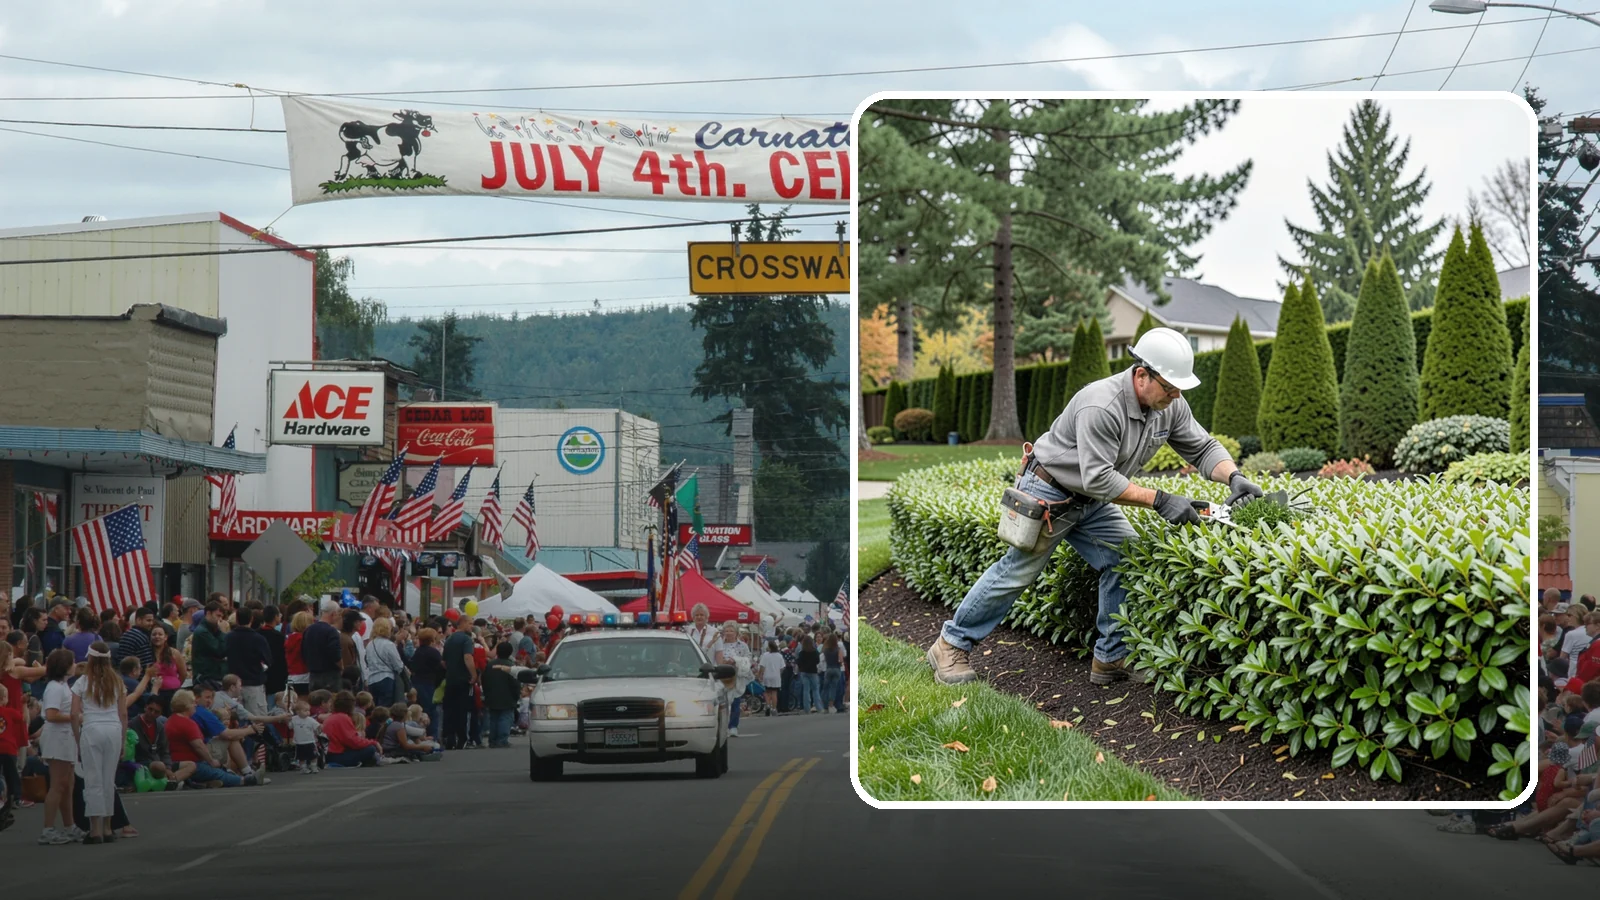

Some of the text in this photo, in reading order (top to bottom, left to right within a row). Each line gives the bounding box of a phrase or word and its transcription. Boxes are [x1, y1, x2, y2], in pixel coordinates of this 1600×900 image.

[481, 141, 605, 192] JULY
[633, 150, 746, 198] 4th.
[696, 254, 850, 280] CROSSWA
[283, 380, 373, 420] ACE
[405, 409, 485, 422] CEDAR LOG
[283, 421, 371, 436] Hardware
[416, 428, 477, 447] Coca-Cola
[83, 485, 155, 495] St. Vincent de Paul
[688, 526, 741, 535] CRNATION
[699, 535, 730, 543] GLASS
